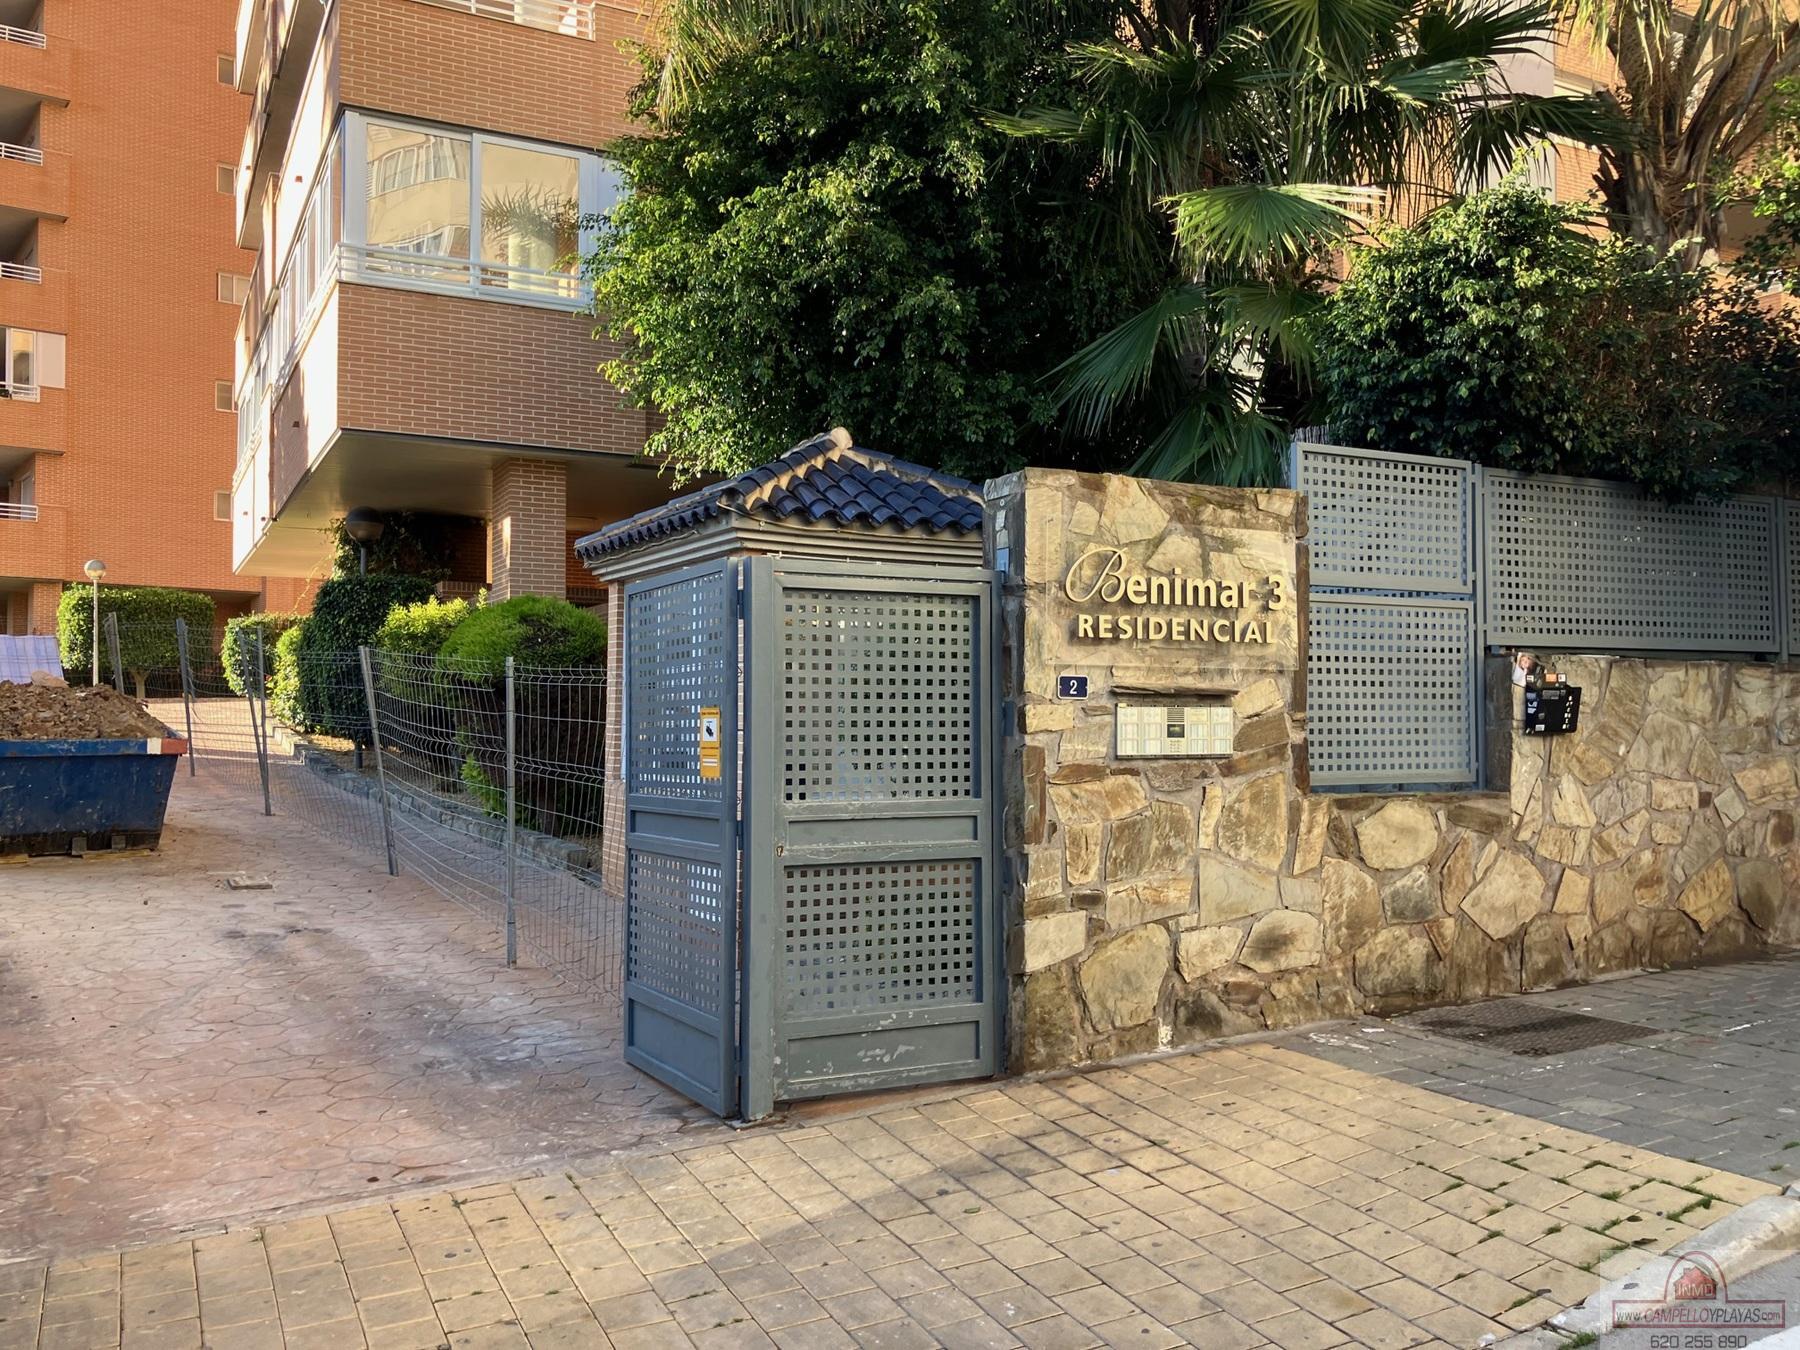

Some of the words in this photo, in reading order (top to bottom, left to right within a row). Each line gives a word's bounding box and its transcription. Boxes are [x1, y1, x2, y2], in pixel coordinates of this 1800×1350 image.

[1065, 547, 1256, 608] Benimar
[1267, 575, 1287, 611] 3
[1078, 614, 1275, 644] RESIDENCIAL
[1069, 680, 1078, 695] 2
